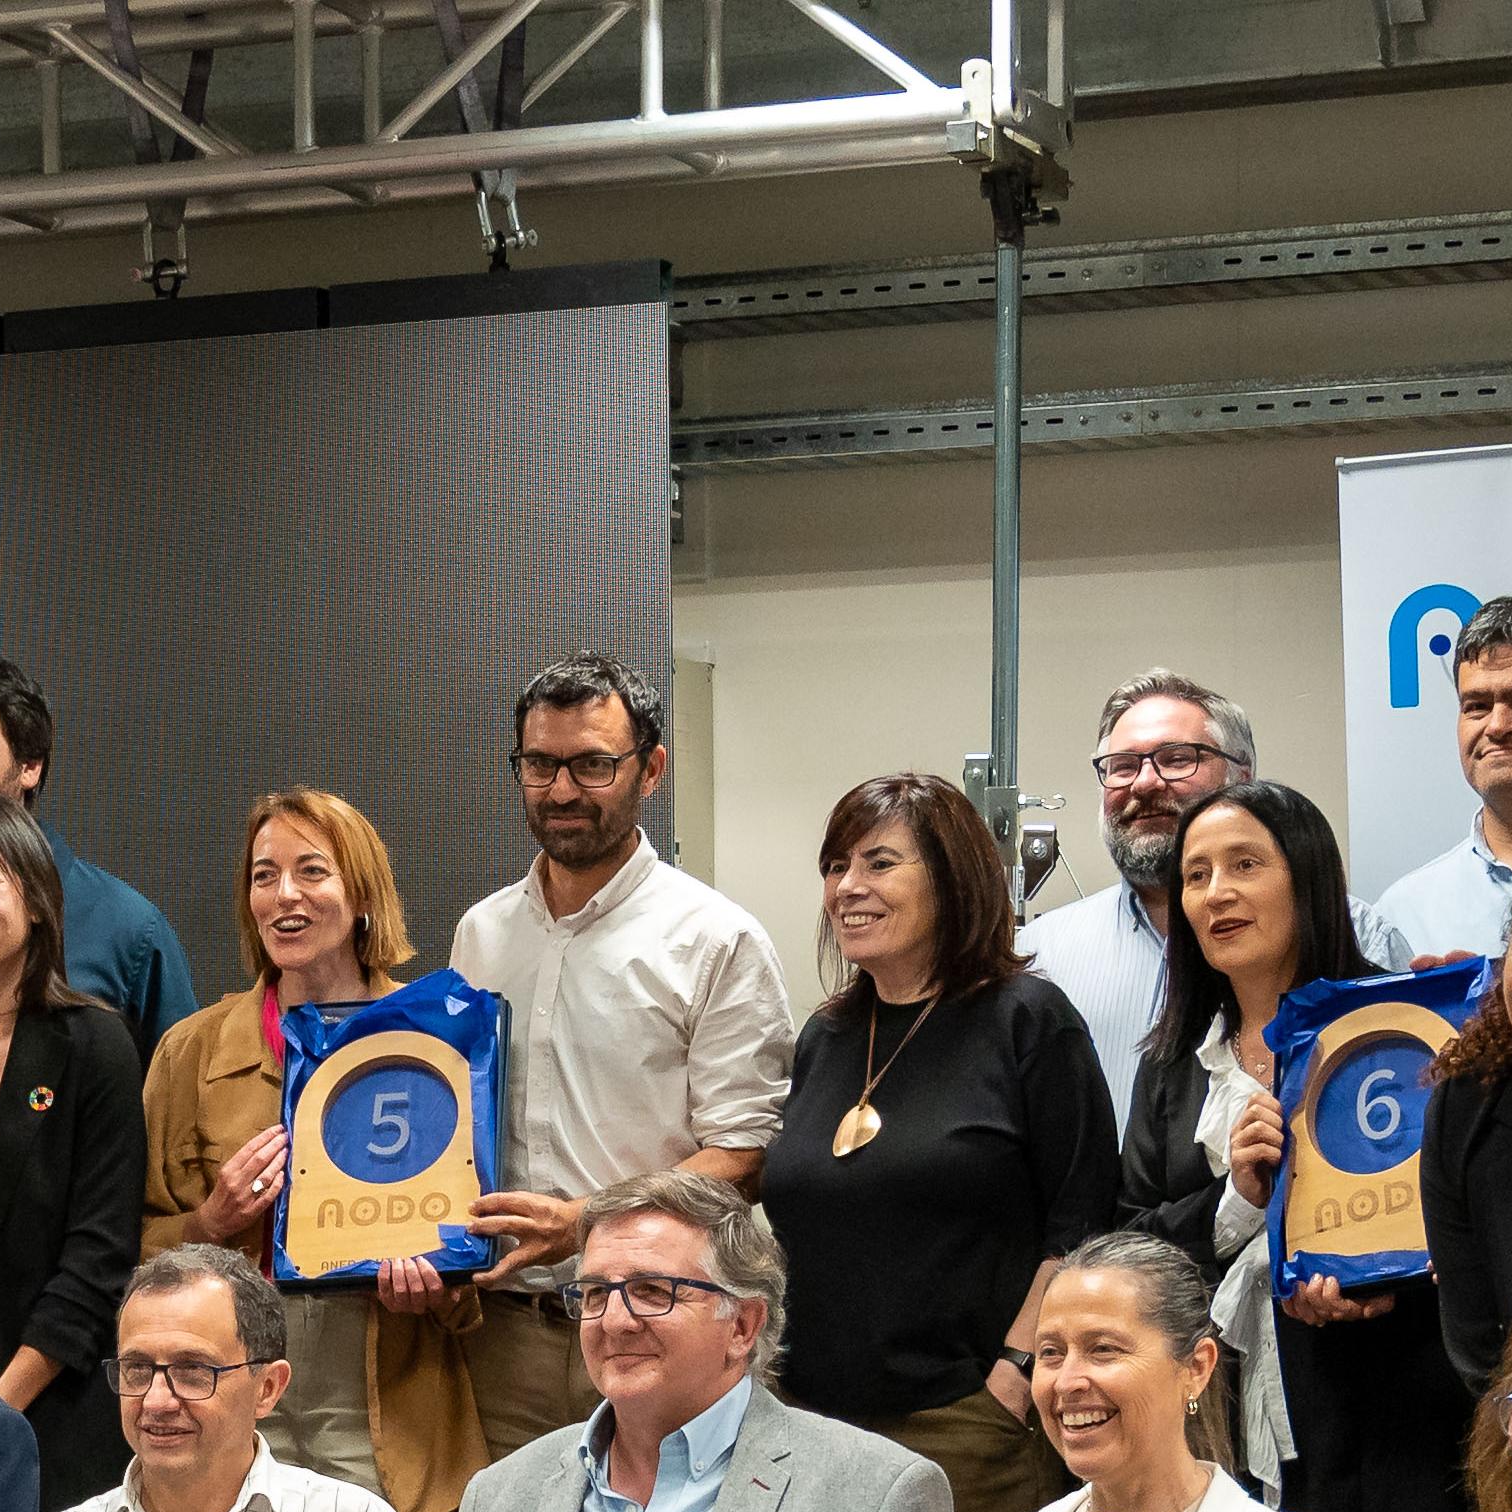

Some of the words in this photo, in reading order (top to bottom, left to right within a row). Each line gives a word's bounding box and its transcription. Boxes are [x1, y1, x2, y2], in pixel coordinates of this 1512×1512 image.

[366, 1091, 411, 1157] 5
[1356, 1068, 1401, 1141] 6
[317, 1192, 451, 1229] NODO
[1315, 1181, 1415, 1234] NOD
